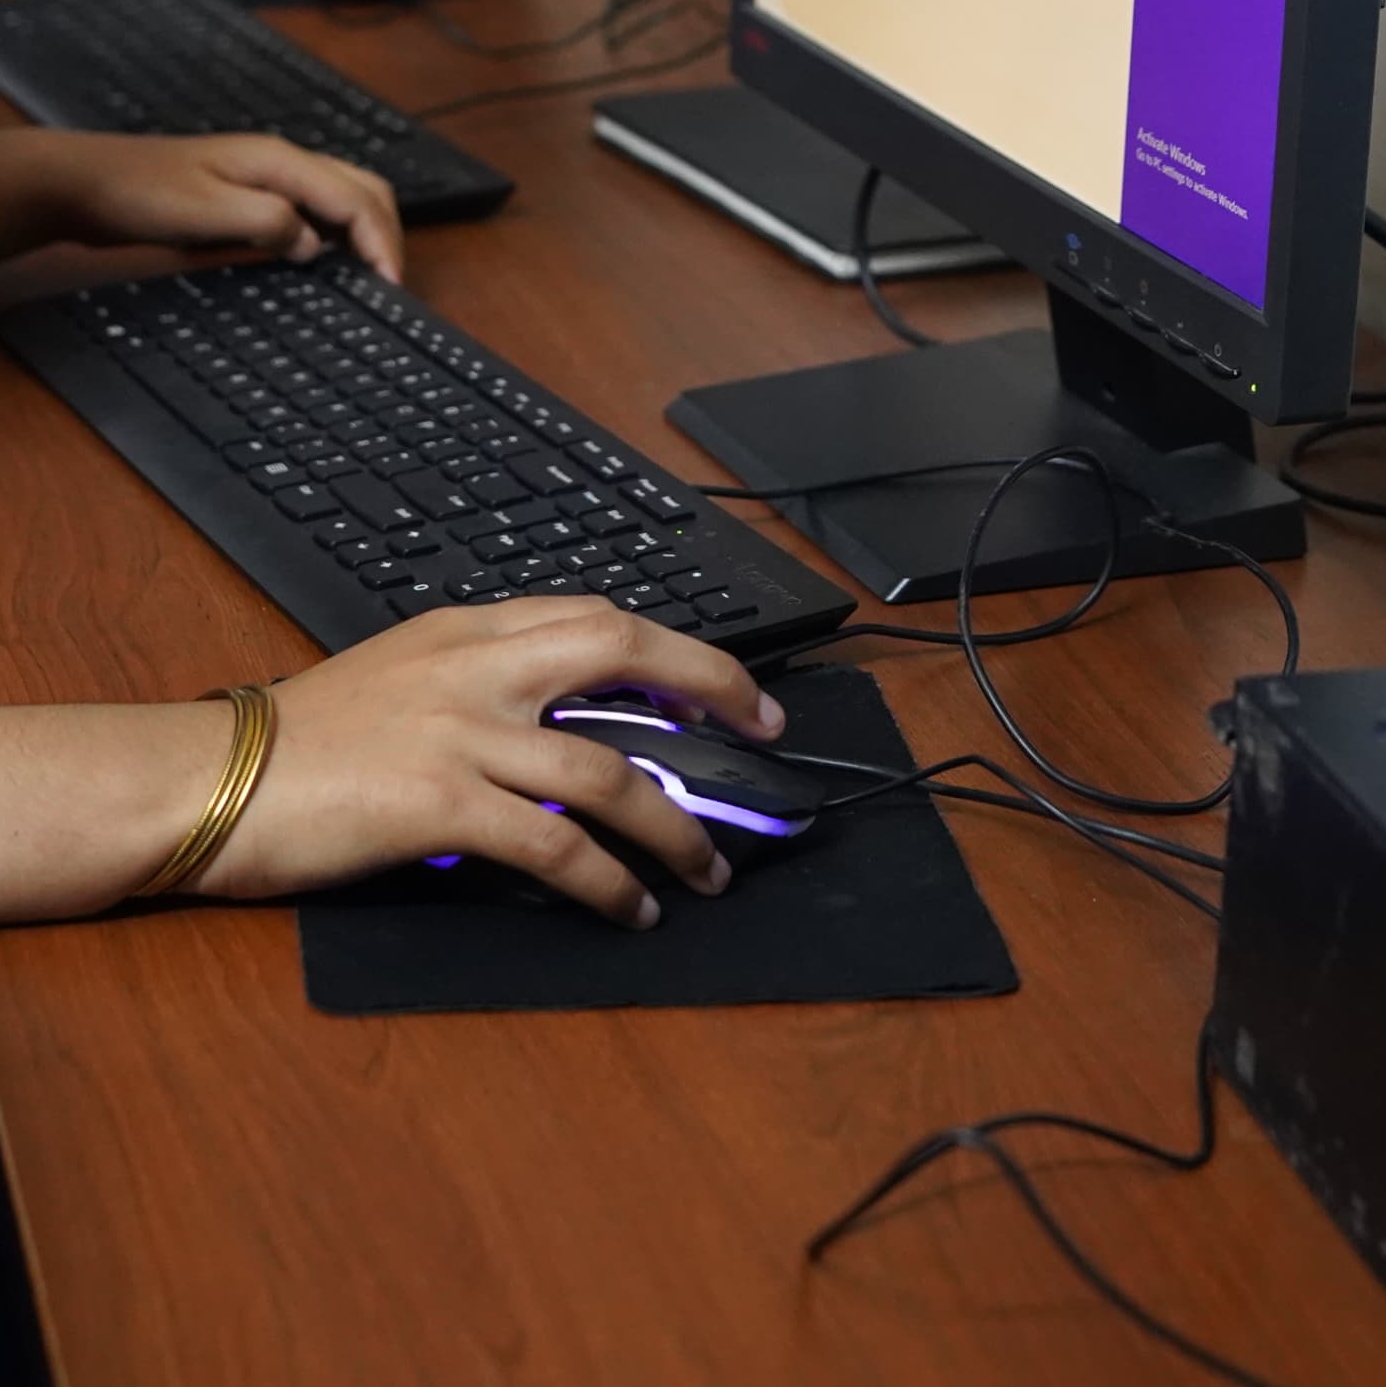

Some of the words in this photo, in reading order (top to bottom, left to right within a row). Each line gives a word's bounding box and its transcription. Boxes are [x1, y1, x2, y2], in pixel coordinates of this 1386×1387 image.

[1136, 147, 1146, 162] Go
[1185, 176, 1193, 189] to
[1193, 181, 1218, 203] activate
[1137, 126, 1169, 155] Activate
[1169, 143, 1206, 176] Windows
